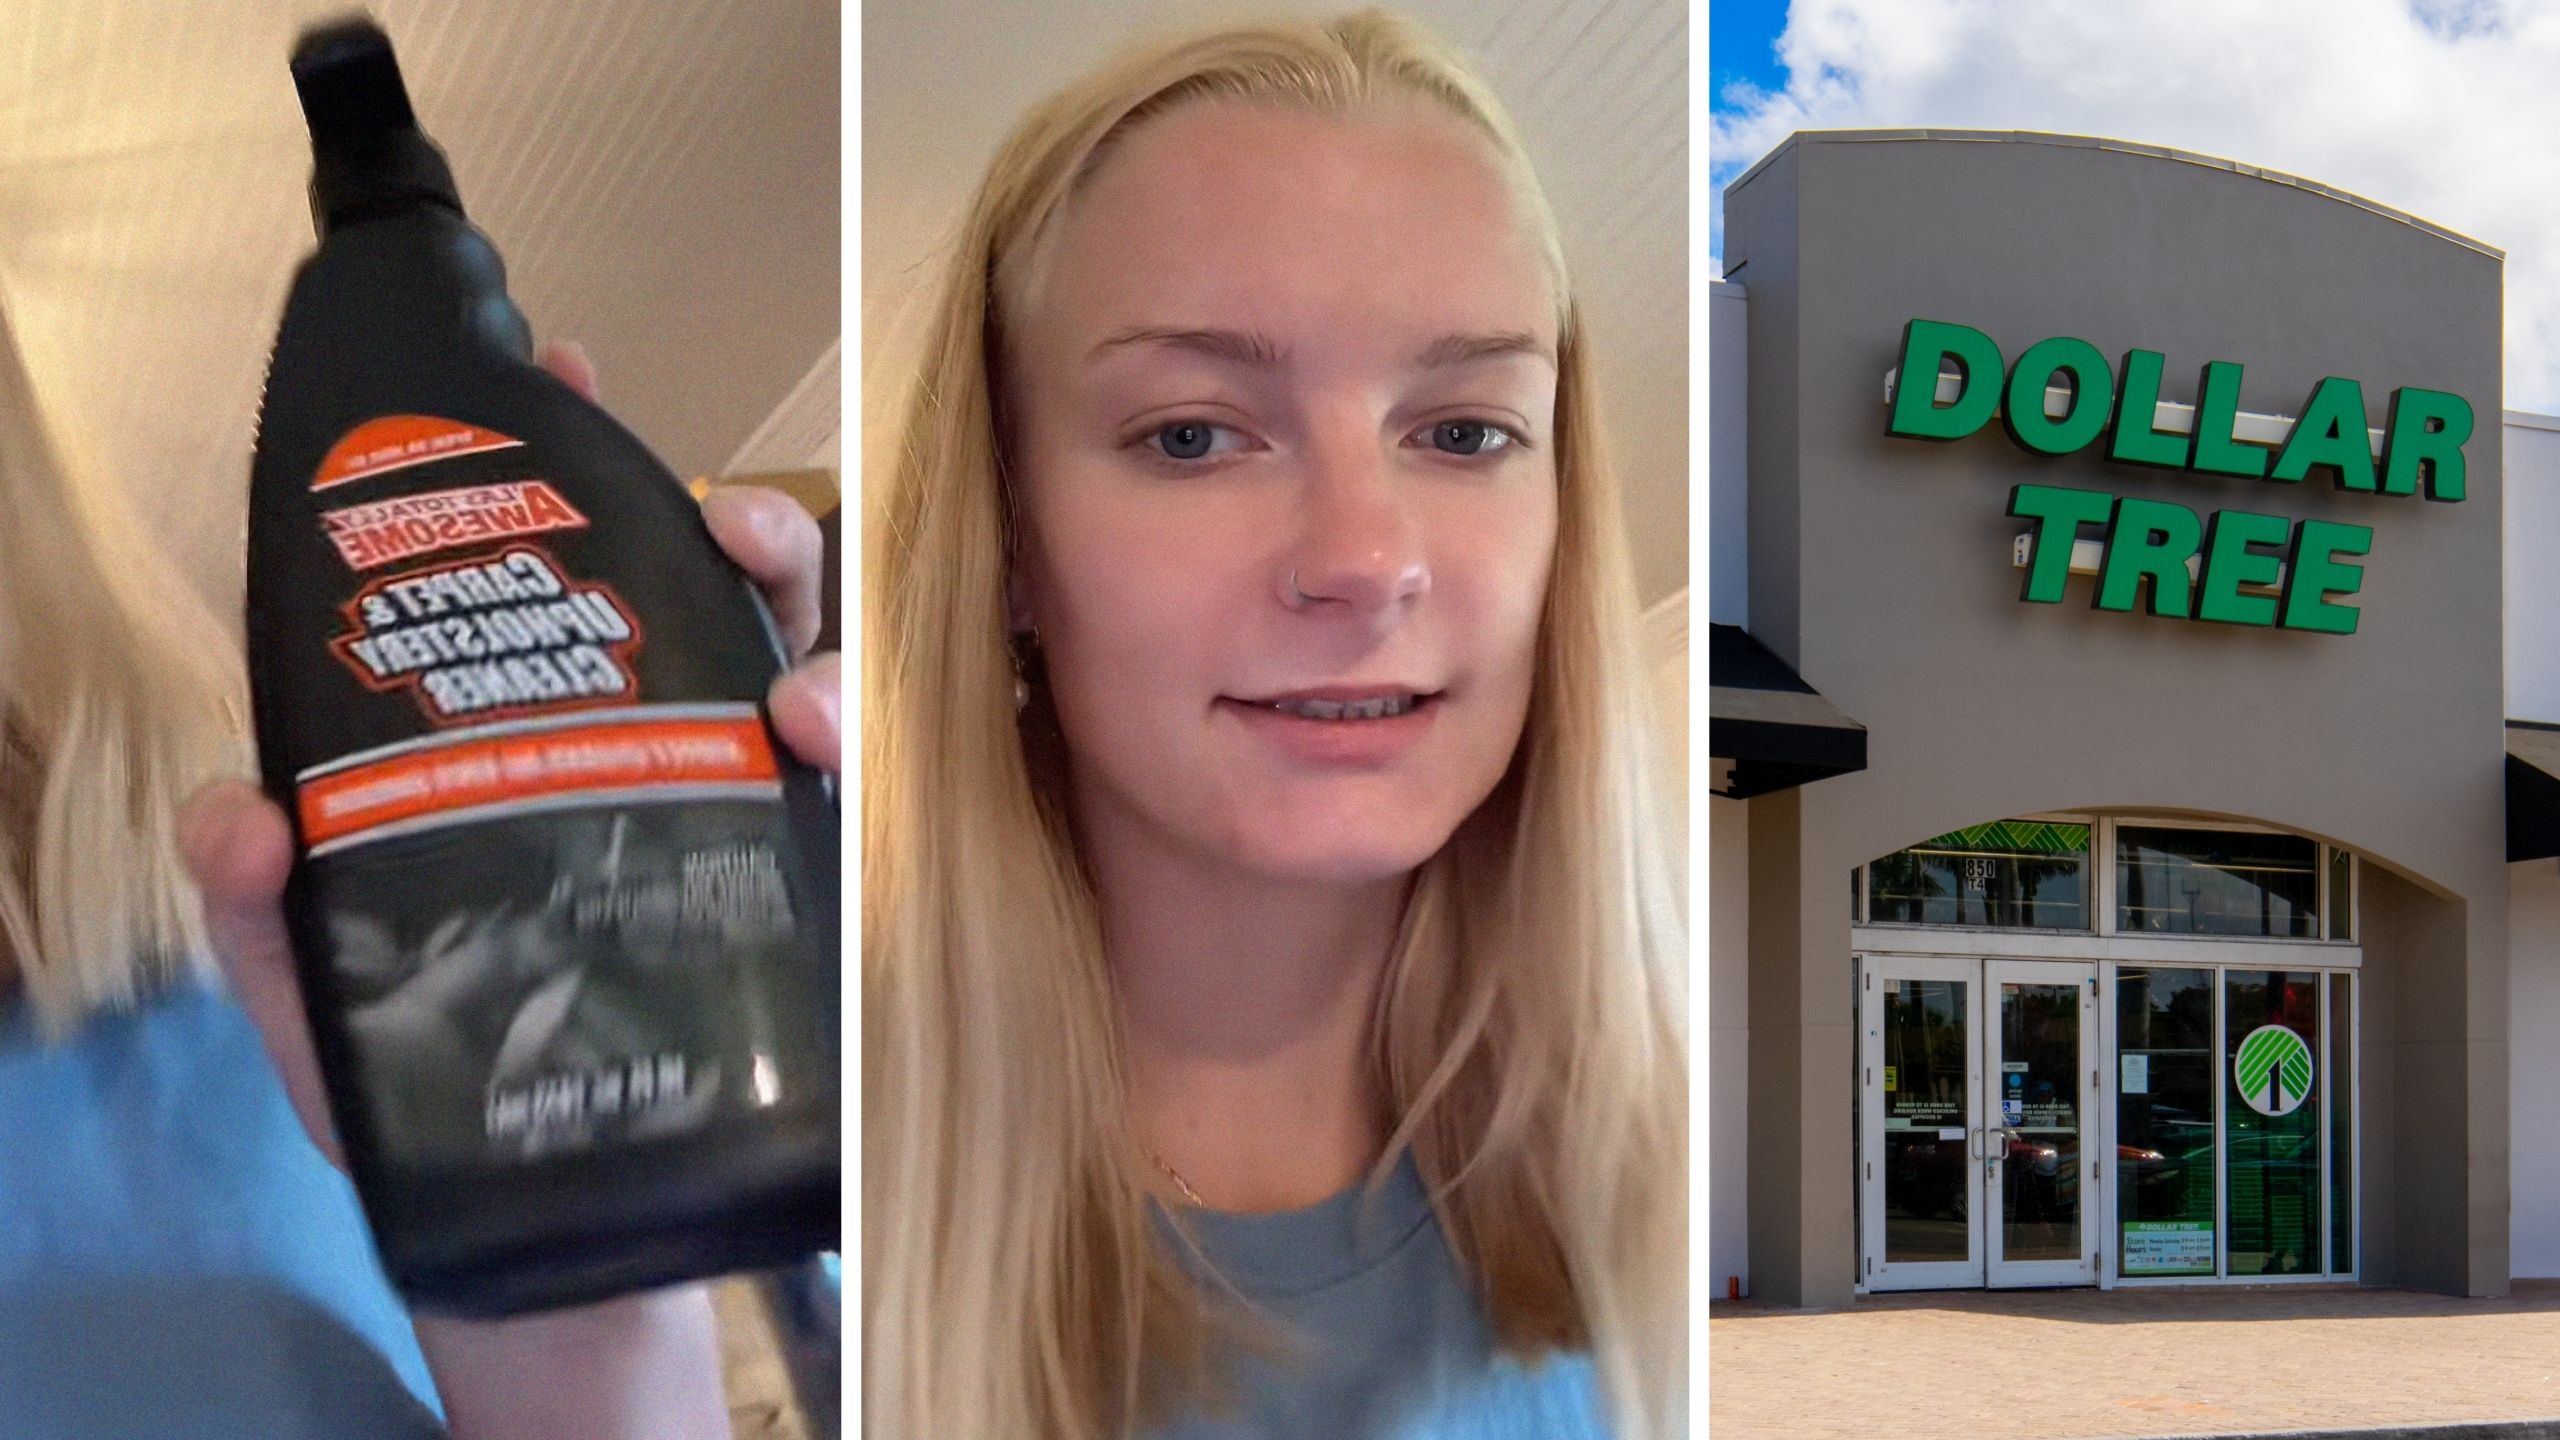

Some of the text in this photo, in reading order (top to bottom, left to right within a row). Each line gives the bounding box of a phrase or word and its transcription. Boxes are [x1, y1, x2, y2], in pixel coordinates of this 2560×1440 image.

[1885, 319, 2474, 503] DOLLAR
[2006, 484, 2374, 635] TREE
[1967, 859, 1994, 877] 850
[1968, 879, 1985, 890] T4
[2146, 1223, 2200, 1232] DOLLAR TREE
[2126, 1236, 2146, 1245] Store
